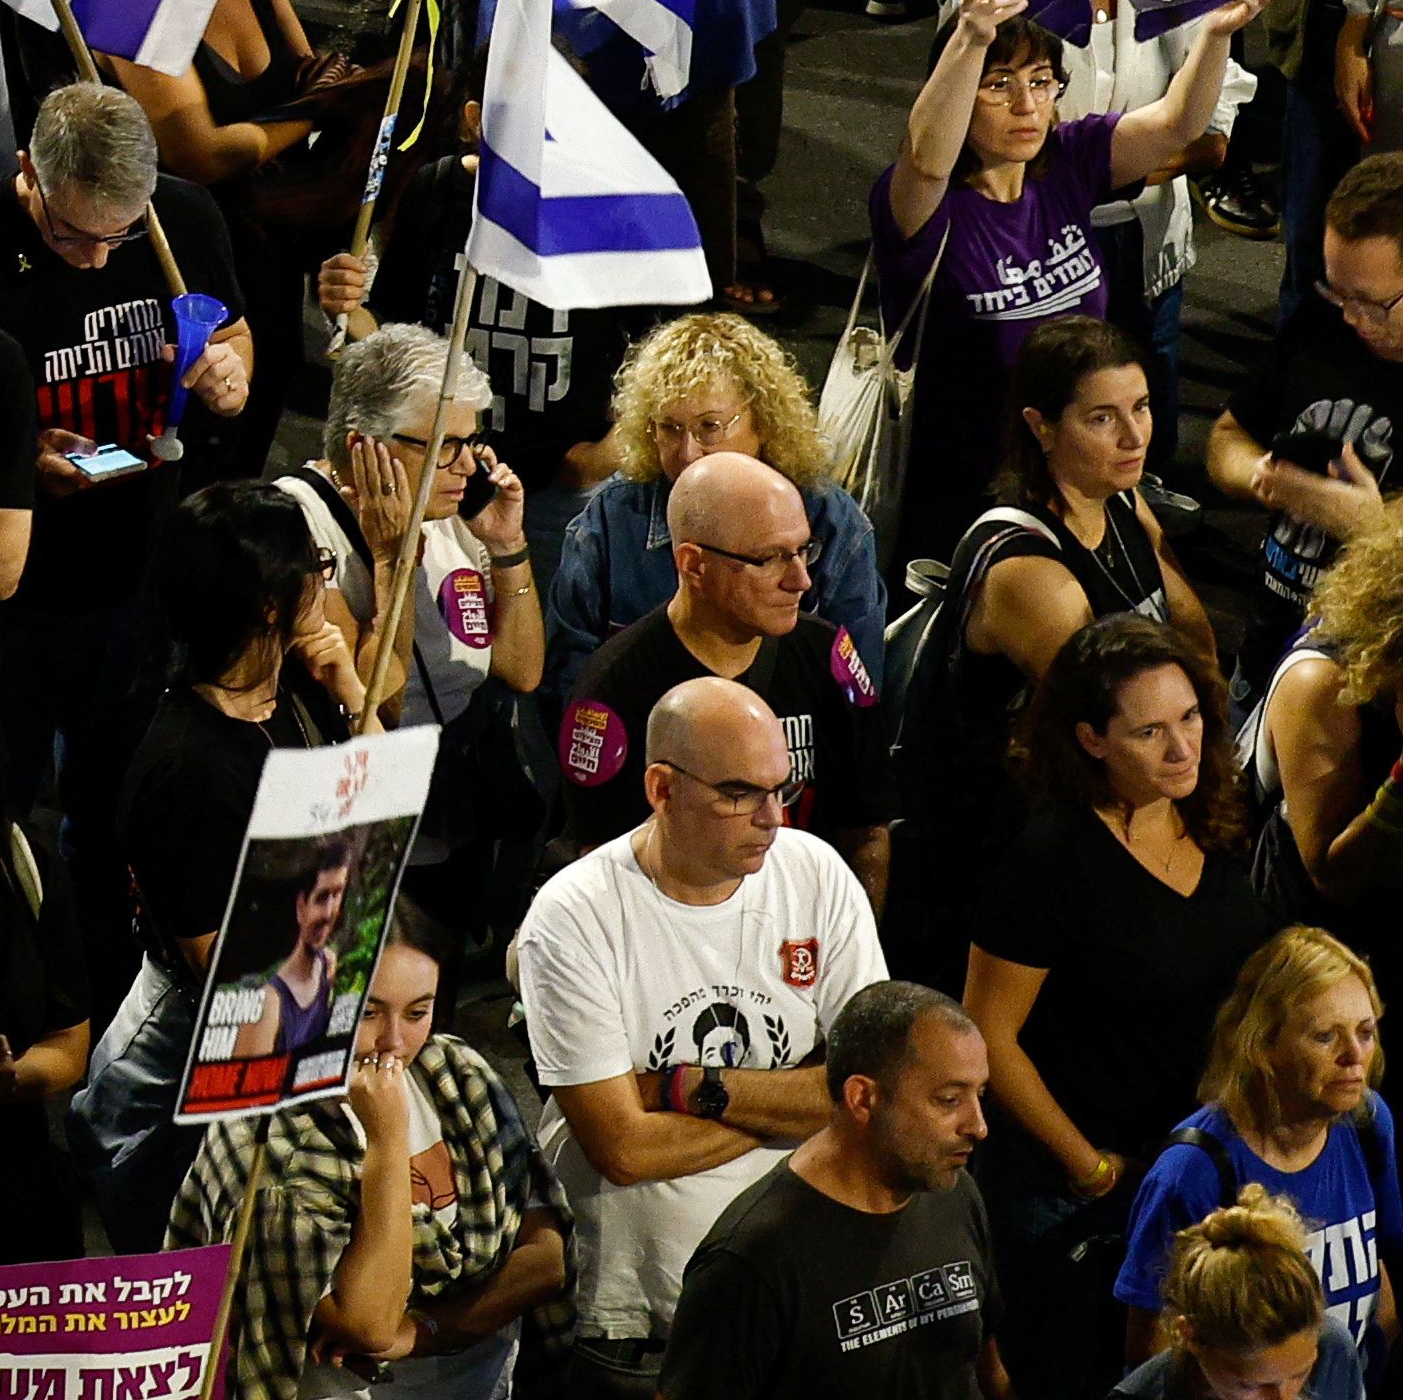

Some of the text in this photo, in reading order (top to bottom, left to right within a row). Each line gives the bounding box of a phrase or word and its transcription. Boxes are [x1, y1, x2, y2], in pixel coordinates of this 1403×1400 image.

[966, 283, 1031, 313] ביחד
[84, 298, 163, 343] מחזירים
[44, 339, 112, 383] הביתה
[198, 1024, 238, 1063] HIM
[57, 1284, 106, 1308] את
[113, 1270, 193, 1303] לקבל
[917, 1281, 944, 1301] Ca
[947, 1273, 975, 1291] Sm
[114, 1301, 193, 1329] לעצור
[848, 1305, 865, 1325] S
[884, 1292, 907, 1315] Ar
[64, 1312, 107, 1334] את
[839, 1338, 862, 1355] THE
[861, 1321, 908, 1347] ELEMENTS
[908, 1317, 918, 1331] OF
[78, 1352, 206, 1400] לצאת
